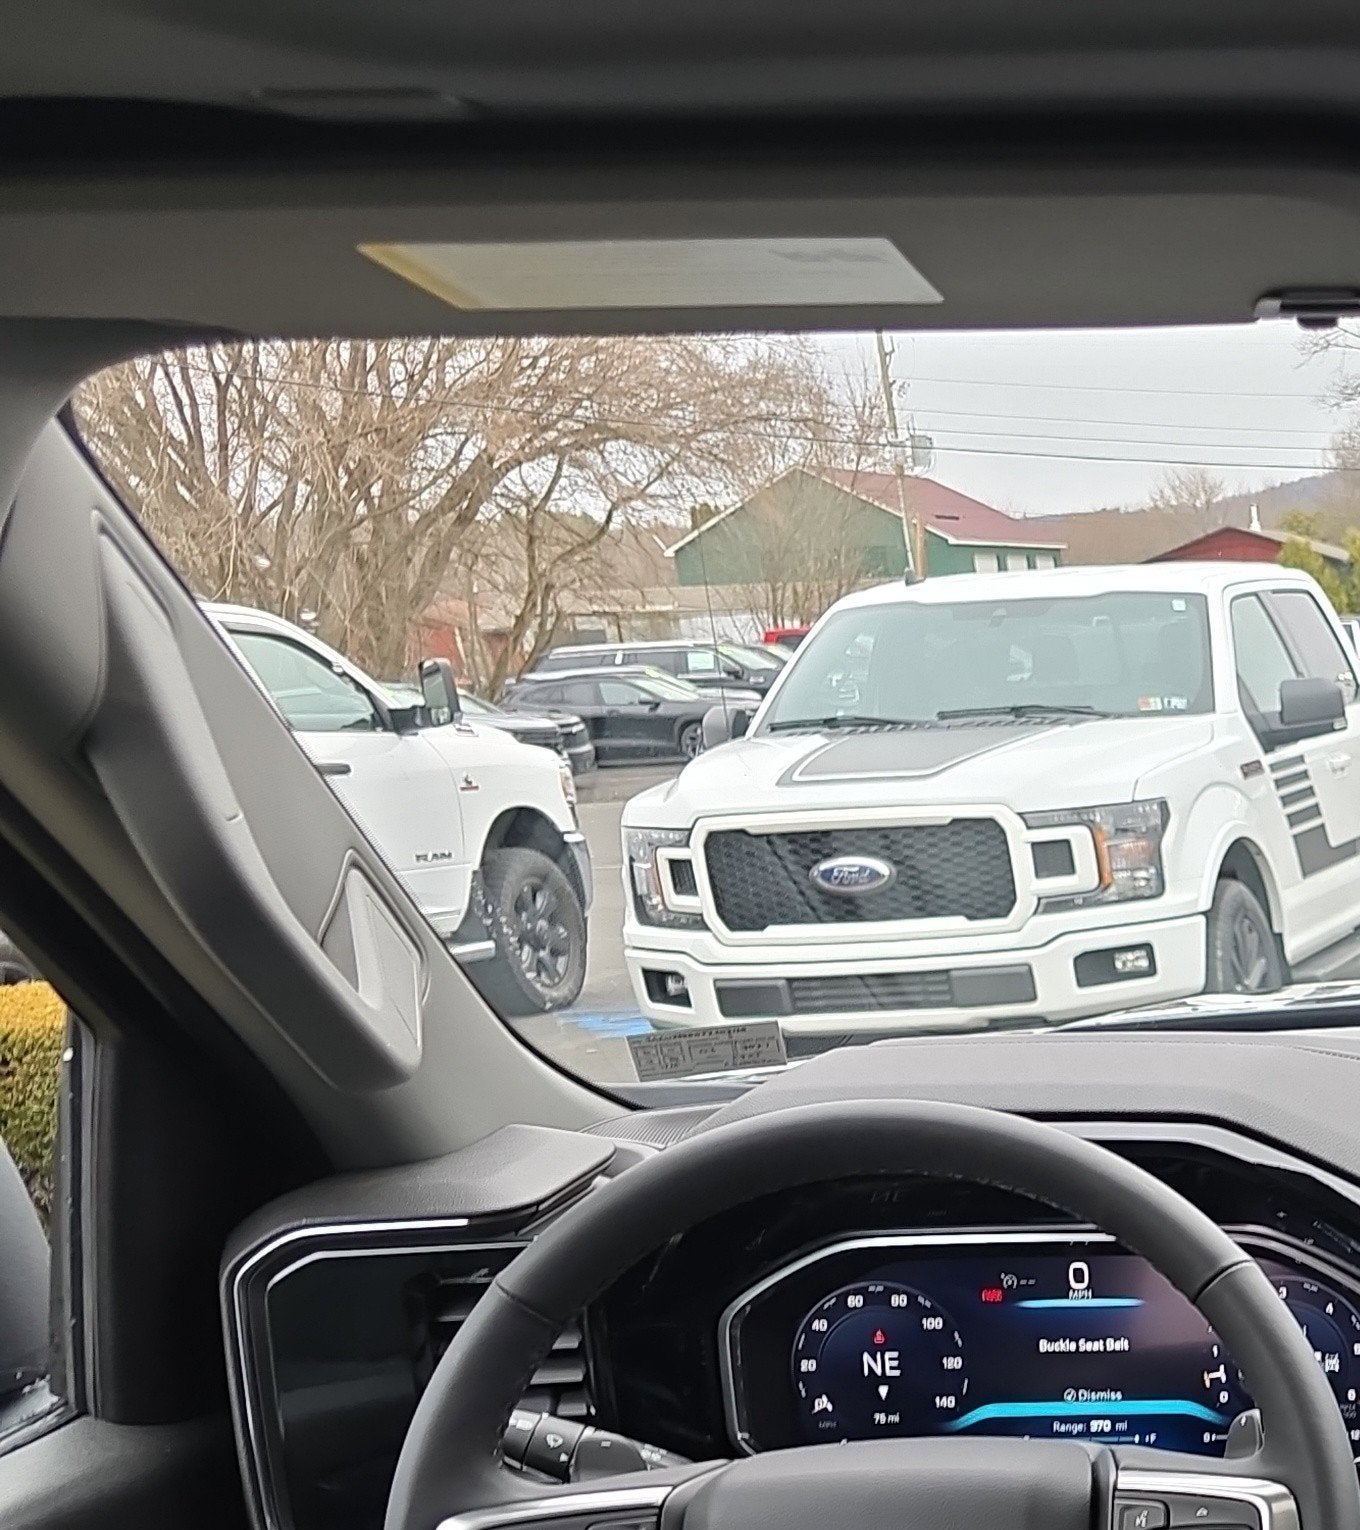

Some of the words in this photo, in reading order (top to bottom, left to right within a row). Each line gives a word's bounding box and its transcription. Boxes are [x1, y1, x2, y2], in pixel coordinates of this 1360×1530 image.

[831, 866, 872, 886] Ford
[1068, 1261, 1090, 1290] 0
[847, 1295, 863, 1308] 60
[891, 1294, 907, 1307] 80
[1325, 1302, 1333, 1315] 4
[812, 1319, 828, 1332] 40
[922, 1317, 943, 1330] 100
[1039, 1338, 1077, 1353] Buckle
[1078, 1338, 1104, 1352] Seat
[1106, 1337, 1130, 1352] Belt
[801, 1359, 817, 1372] 20
[862, 1351, 901, 1377] NE
[942, 1356, 962, 1370] 120
[935, 1395, 955, 1408] 140
[1078, 1388, 1123, 1402] Dismiss
[888, 1412, 900, 1423] mi
[1053, 1420, 1087, 1433] Range:
[1115, 1420, 1127, 1432] mi
